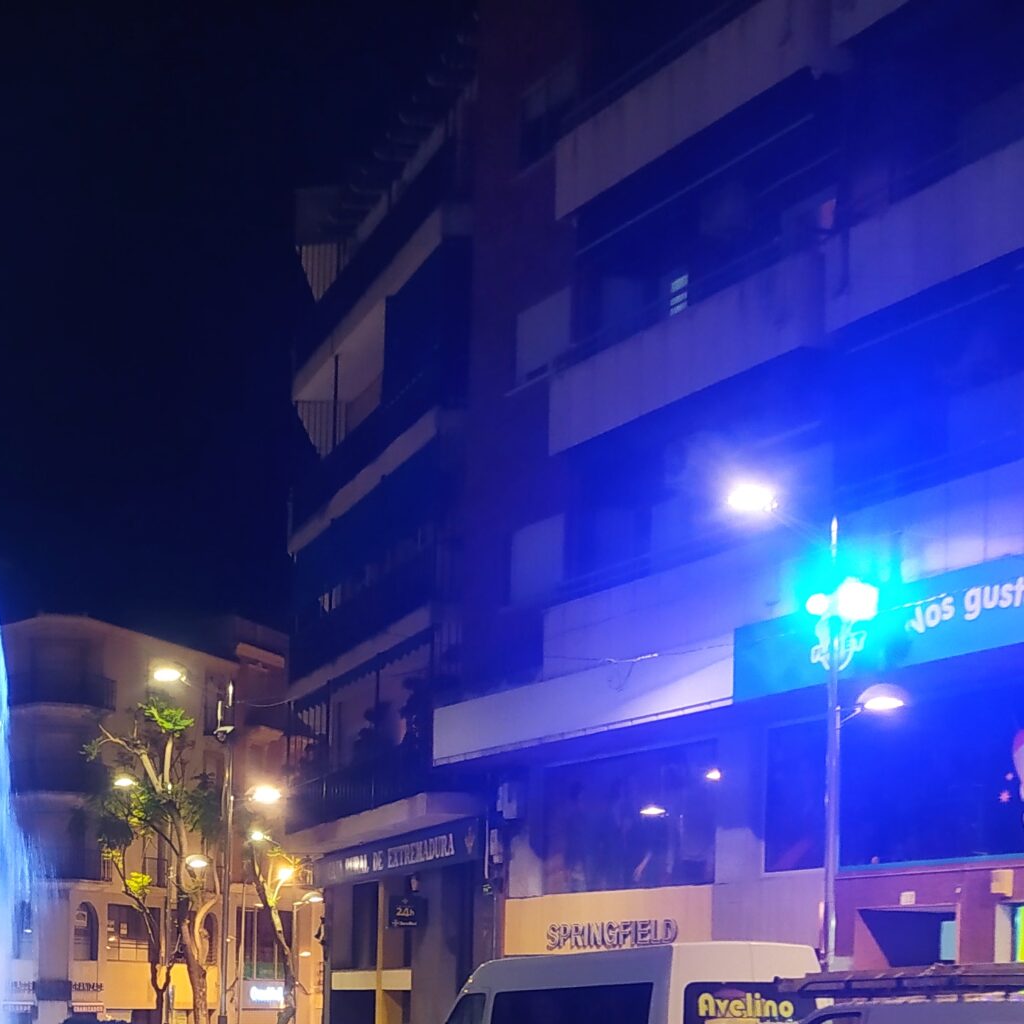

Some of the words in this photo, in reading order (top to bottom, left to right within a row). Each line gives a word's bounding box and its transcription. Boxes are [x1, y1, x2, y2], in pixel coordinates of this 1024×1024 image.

[372, 850, 384, 872] DE
[387, 833, 455, 869] EXTREMADURA
[546, 918, 678, 951] SPRINGFIELD
[698, 992, 794, 1018] Avelino
